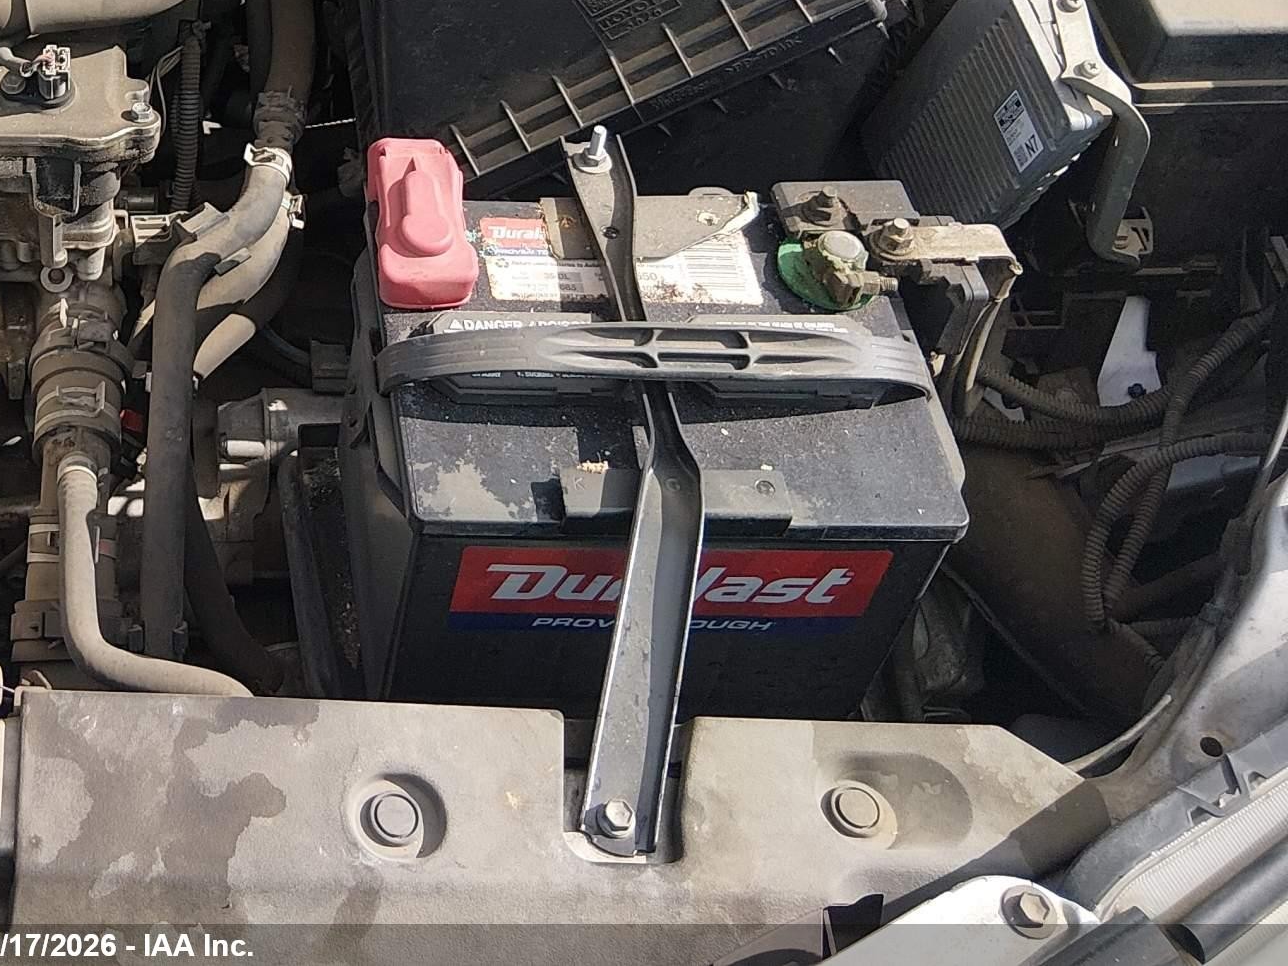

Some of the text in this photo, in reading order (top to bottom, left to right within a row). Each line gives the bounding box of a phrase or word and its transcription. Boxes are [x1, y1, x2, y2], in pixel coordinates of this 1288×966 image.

[1024, 134, 1039, 158] N7
[532, 617, 772, 631] PROV OUGH
